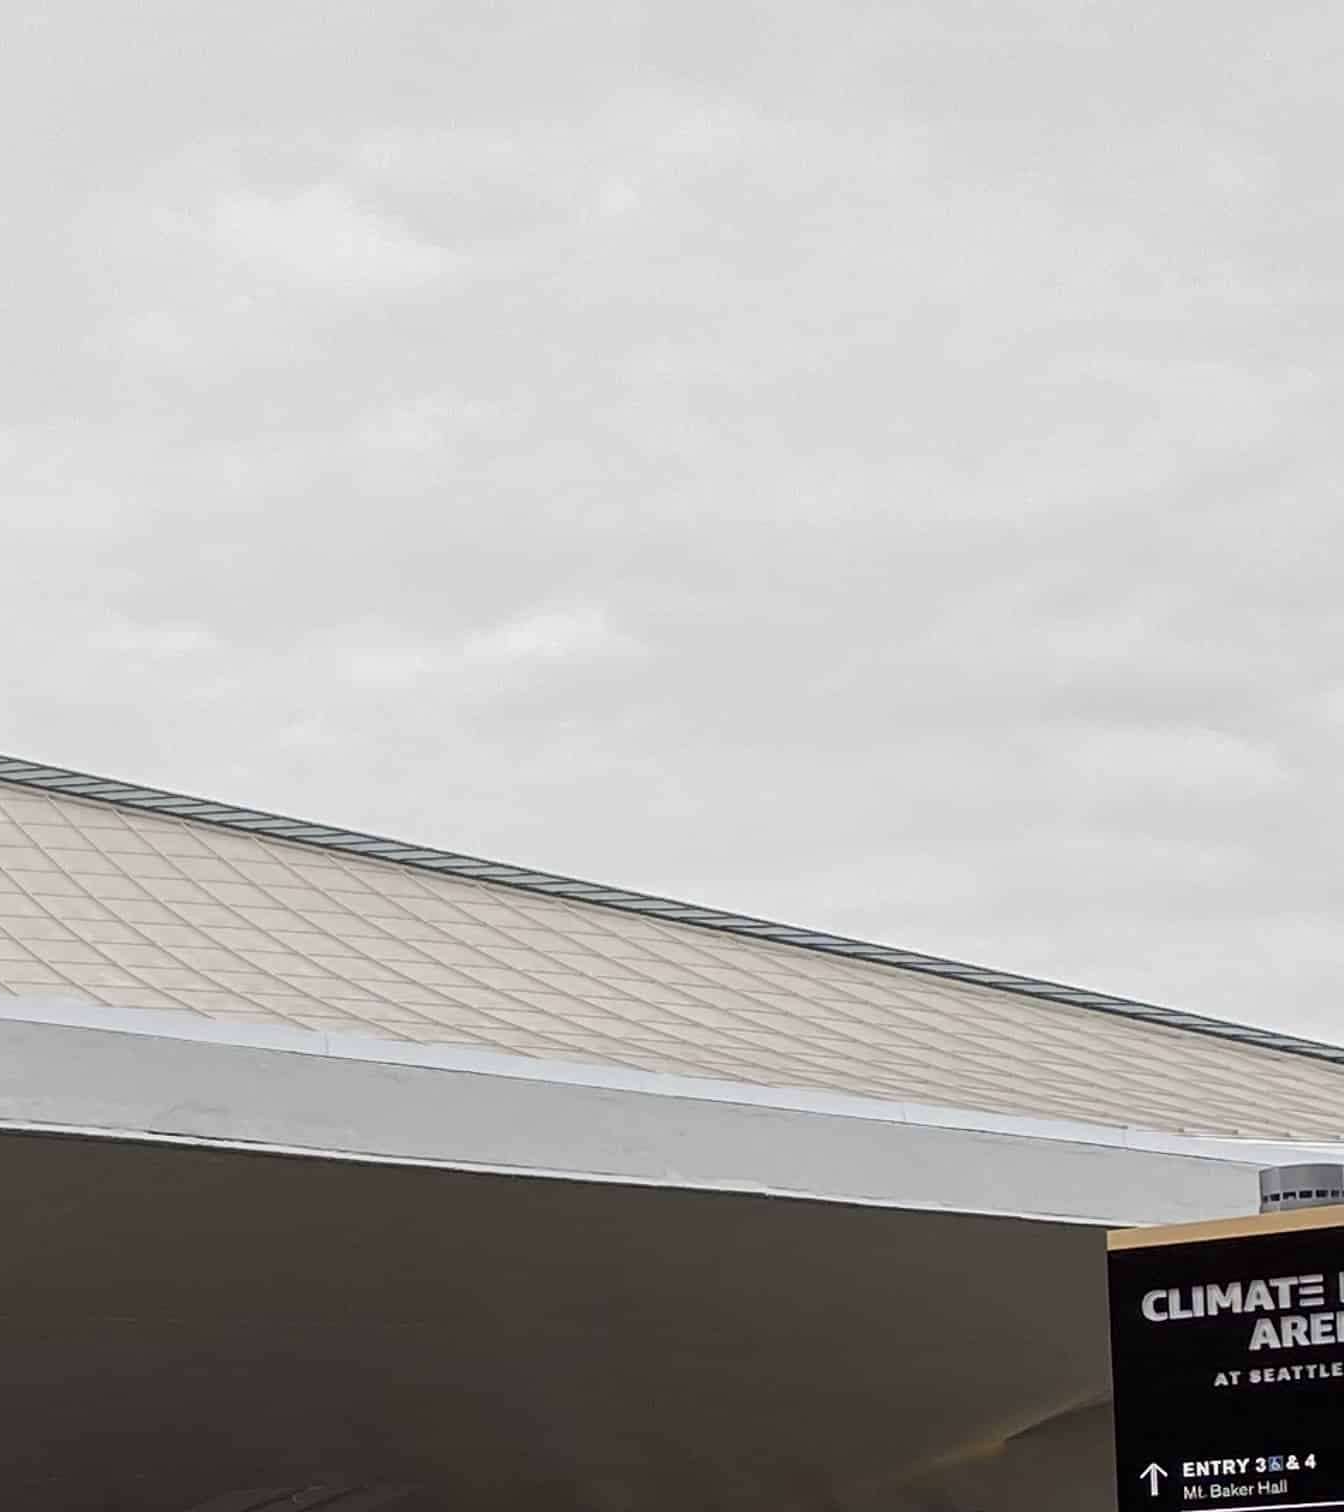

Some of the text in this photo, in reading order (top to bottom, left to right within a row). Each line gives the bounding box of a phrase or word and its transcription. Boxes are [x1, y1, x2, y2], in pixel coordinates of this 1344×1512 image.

[1141, 1273, 1325, 1322] CLIMATE
[1214, 1362, 1343, 1386] AT SEATTLE
[1183, 1453, 1317, 1477] ENTRY 3 & 4
[1210, 1483, 1255, 1498] Baker
[1258, 1479, 1288, 1495] Hall
